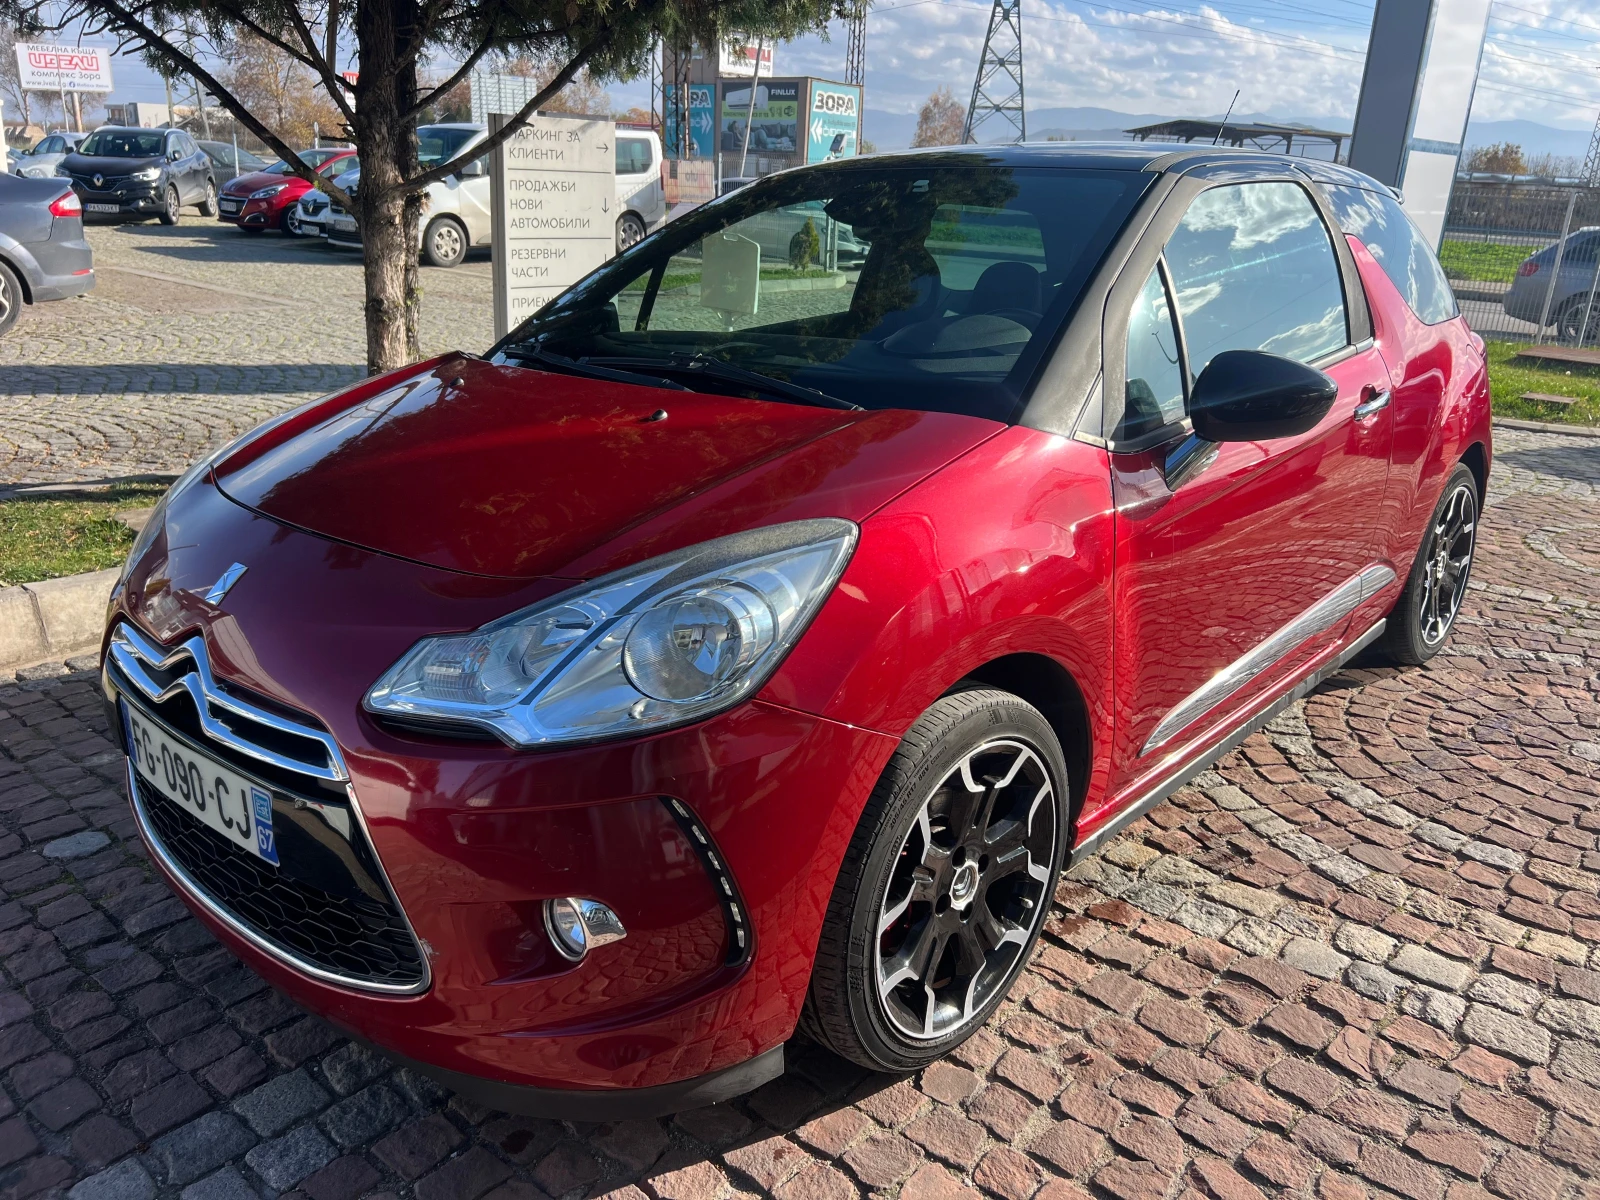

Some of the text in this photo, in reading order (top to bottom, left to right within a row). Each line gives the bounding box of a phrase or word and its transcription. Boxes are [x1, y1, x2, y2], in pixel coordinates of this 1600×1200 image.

[27, 45, 97, 55] МЕБЕЛНА КЪЩА
[79, 71, 101, 81] Зора
[813, 90, 857, 116] ЗОРА
[566, 131, 581, 143] ЗА
[509, 147, 564, 161] КЛИЕНТИ
[509, 179, 576, 193] ПРОДАЖБИ
[509, 198, 543, 211] НОВИ
[510, 217, 590, 229] АВТОМОБИЛИ
[511, 248, 567, 260] РЕЗЕРВНИ
[511, 265, 549, 278] ЧАСТИ
[512, 296, 554, 309] ПРИЕМ
[131, 716, 252, 840] FG-090-CJ
[257, 826, 274, 853] 67
